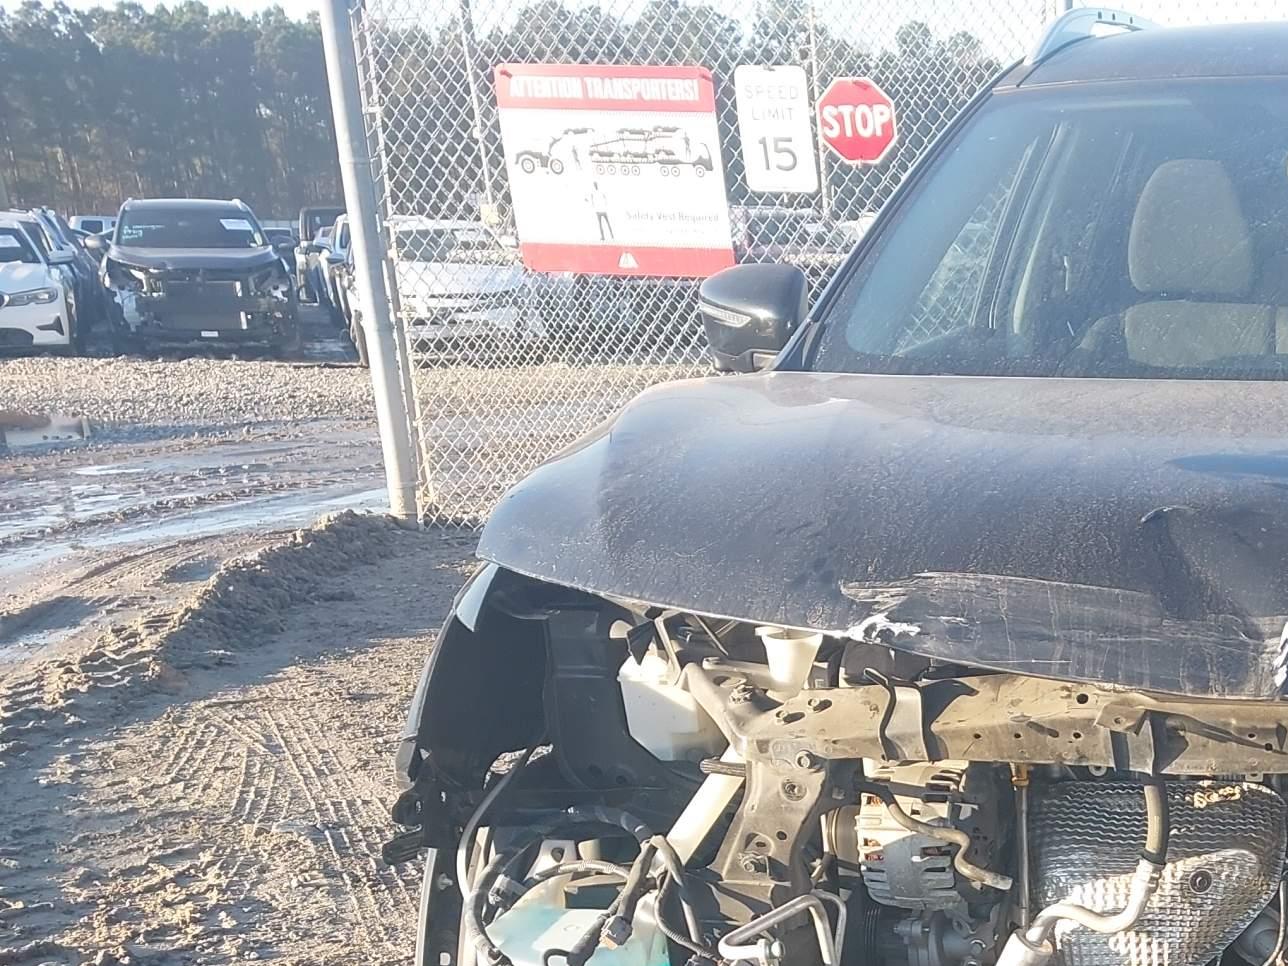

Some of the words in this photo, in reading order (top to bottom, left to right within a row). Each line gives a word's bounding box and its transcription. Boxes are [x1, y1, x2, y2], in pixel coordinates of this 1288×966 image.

[509, 75, 583, 99] ATTENTION
[583, 77, 700, 101] TRANSPORTERS!
[743, 84, 800, 100] SPEED
[751, 106, 794, 121] LIMIT
[822, 103, 891, 138] STOP
[757, 136, 798, 172] 15
[678, 211, 720, 224] Required
